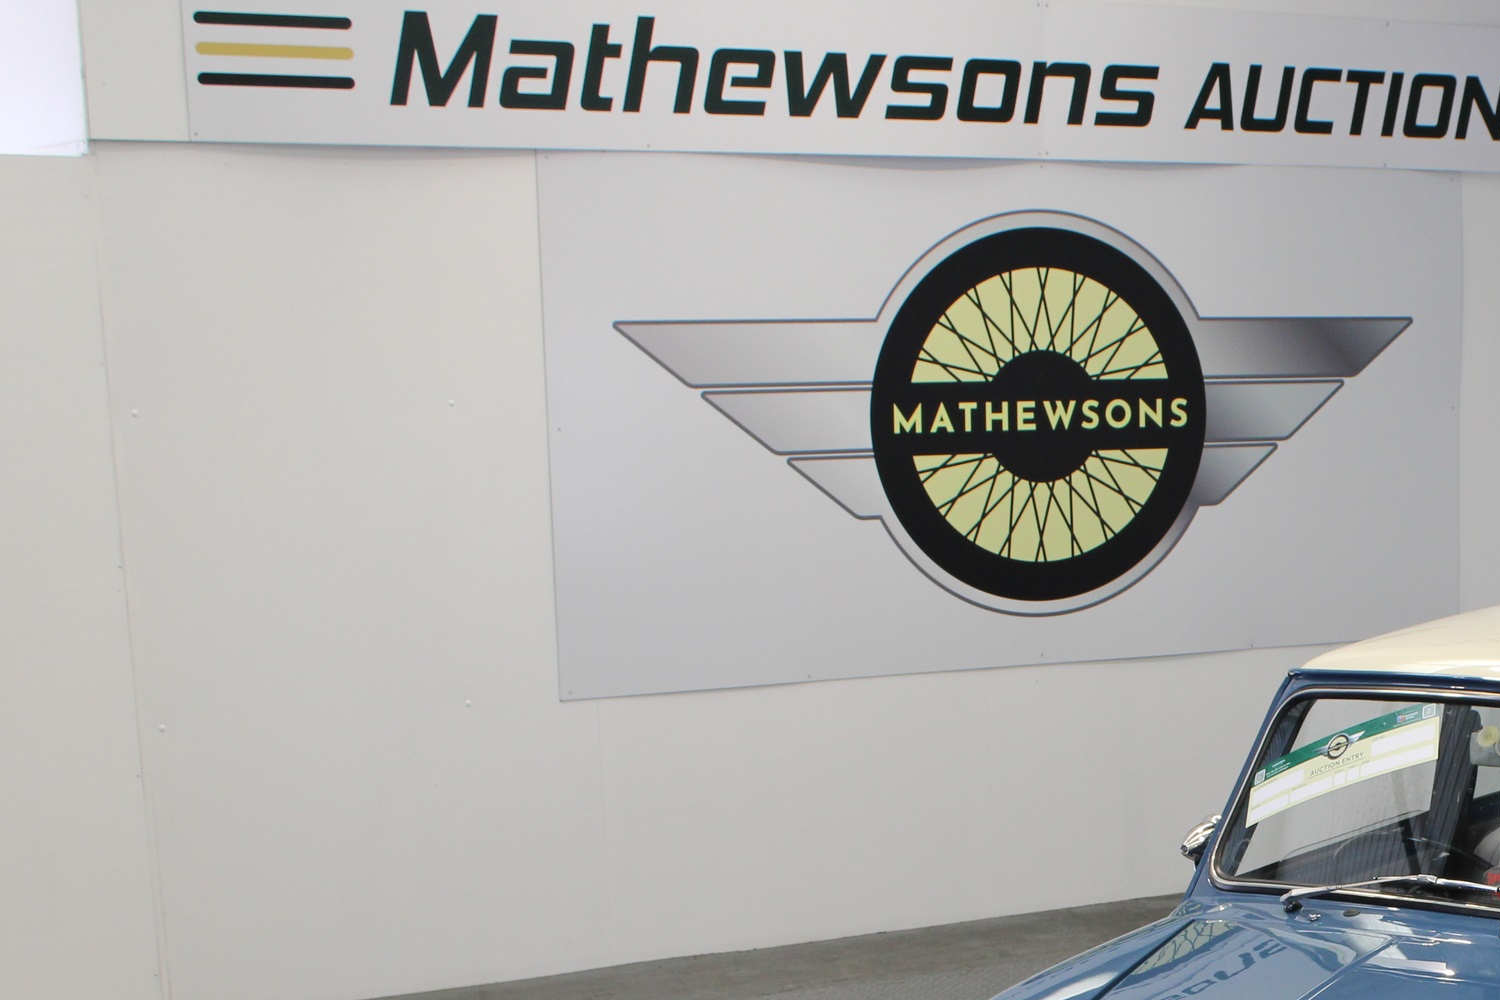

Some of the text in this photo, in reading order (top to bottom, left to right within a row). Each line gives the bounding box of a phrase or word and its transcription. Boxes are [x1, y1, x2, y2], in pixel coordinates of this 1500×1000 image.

[390, 10, 1160, 128] Mathewsons
[893, 397, 1188, 434] MATHEWSONS
[1310, 751, 1364, 776] AUCTION ENTRY
